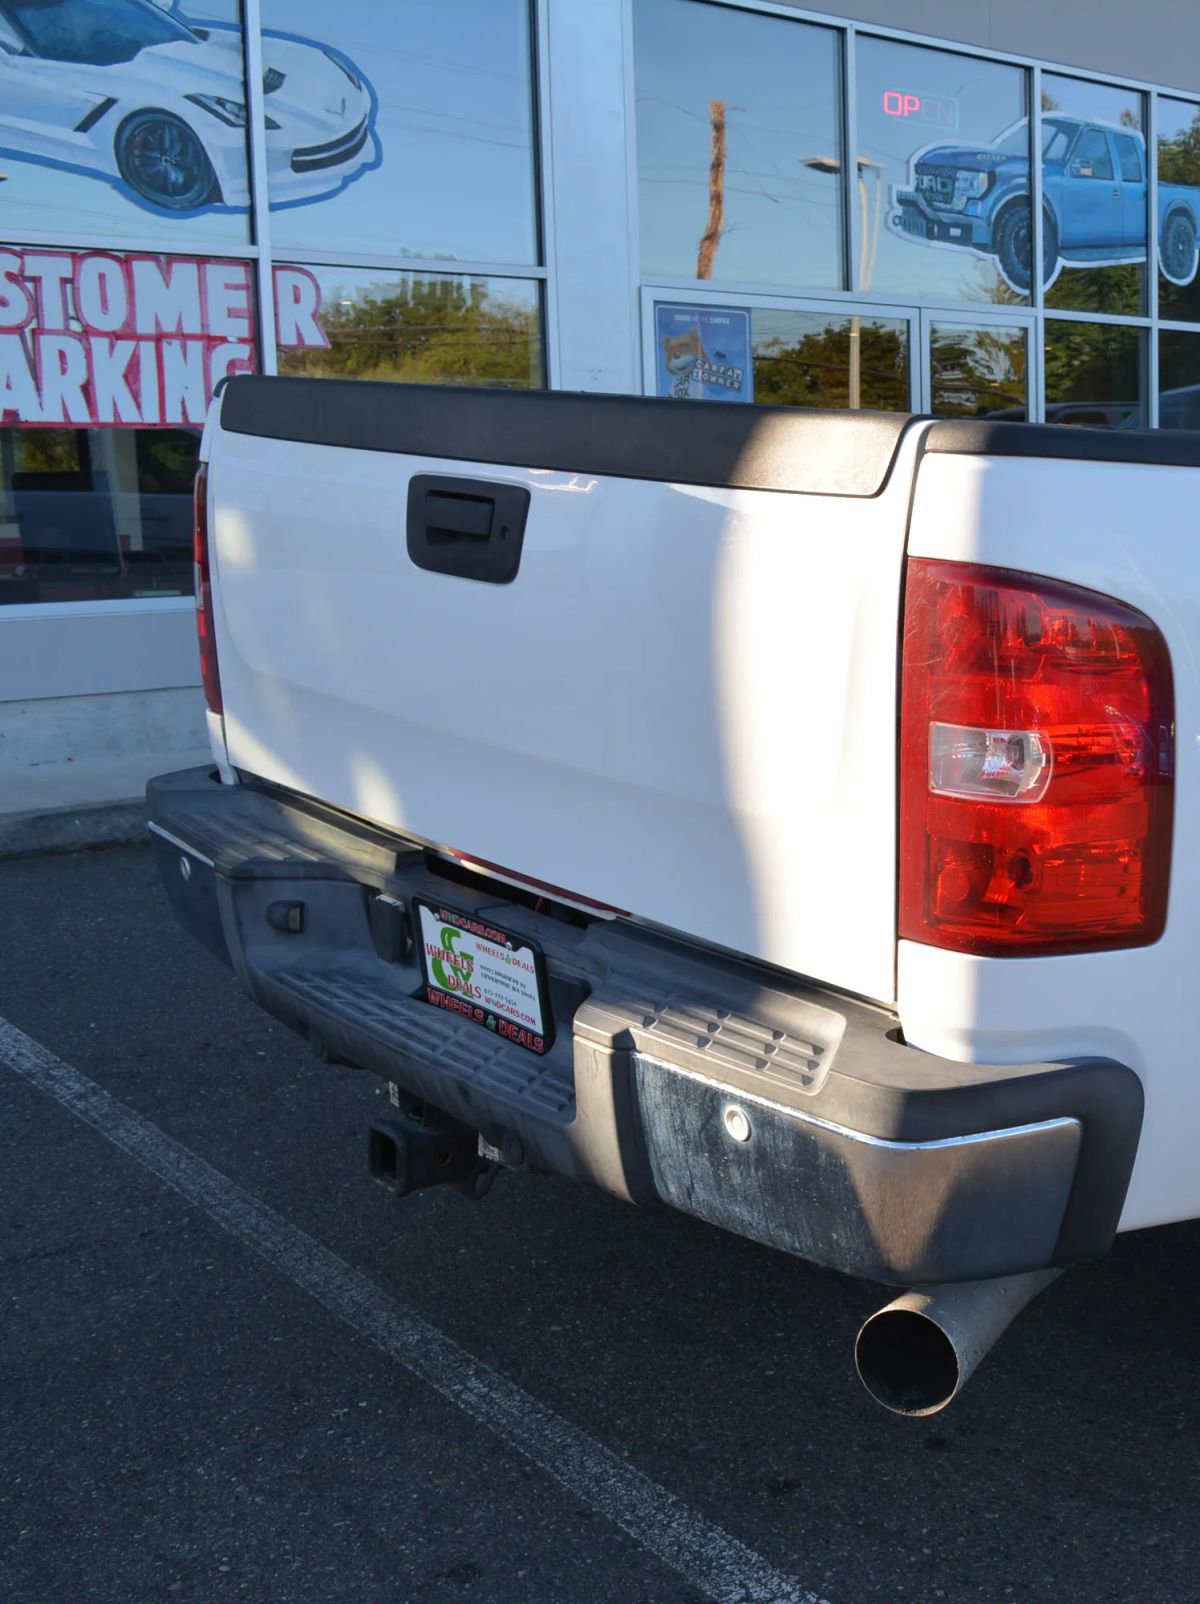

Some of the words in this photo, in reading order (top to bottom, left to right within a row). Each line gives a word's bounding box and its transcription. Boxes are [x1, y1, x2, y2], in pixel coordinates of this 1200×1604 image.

[425, 942, 474, 973] WHEELS
[474, 942, 505, 961] WHEELS
[512, 957, 535, 974] DEALS
[447, 974, 482, 999] DEALS
[427, 987, 485, 1025] WHEELS
[498, 1019, 544, 1054] DEALS
